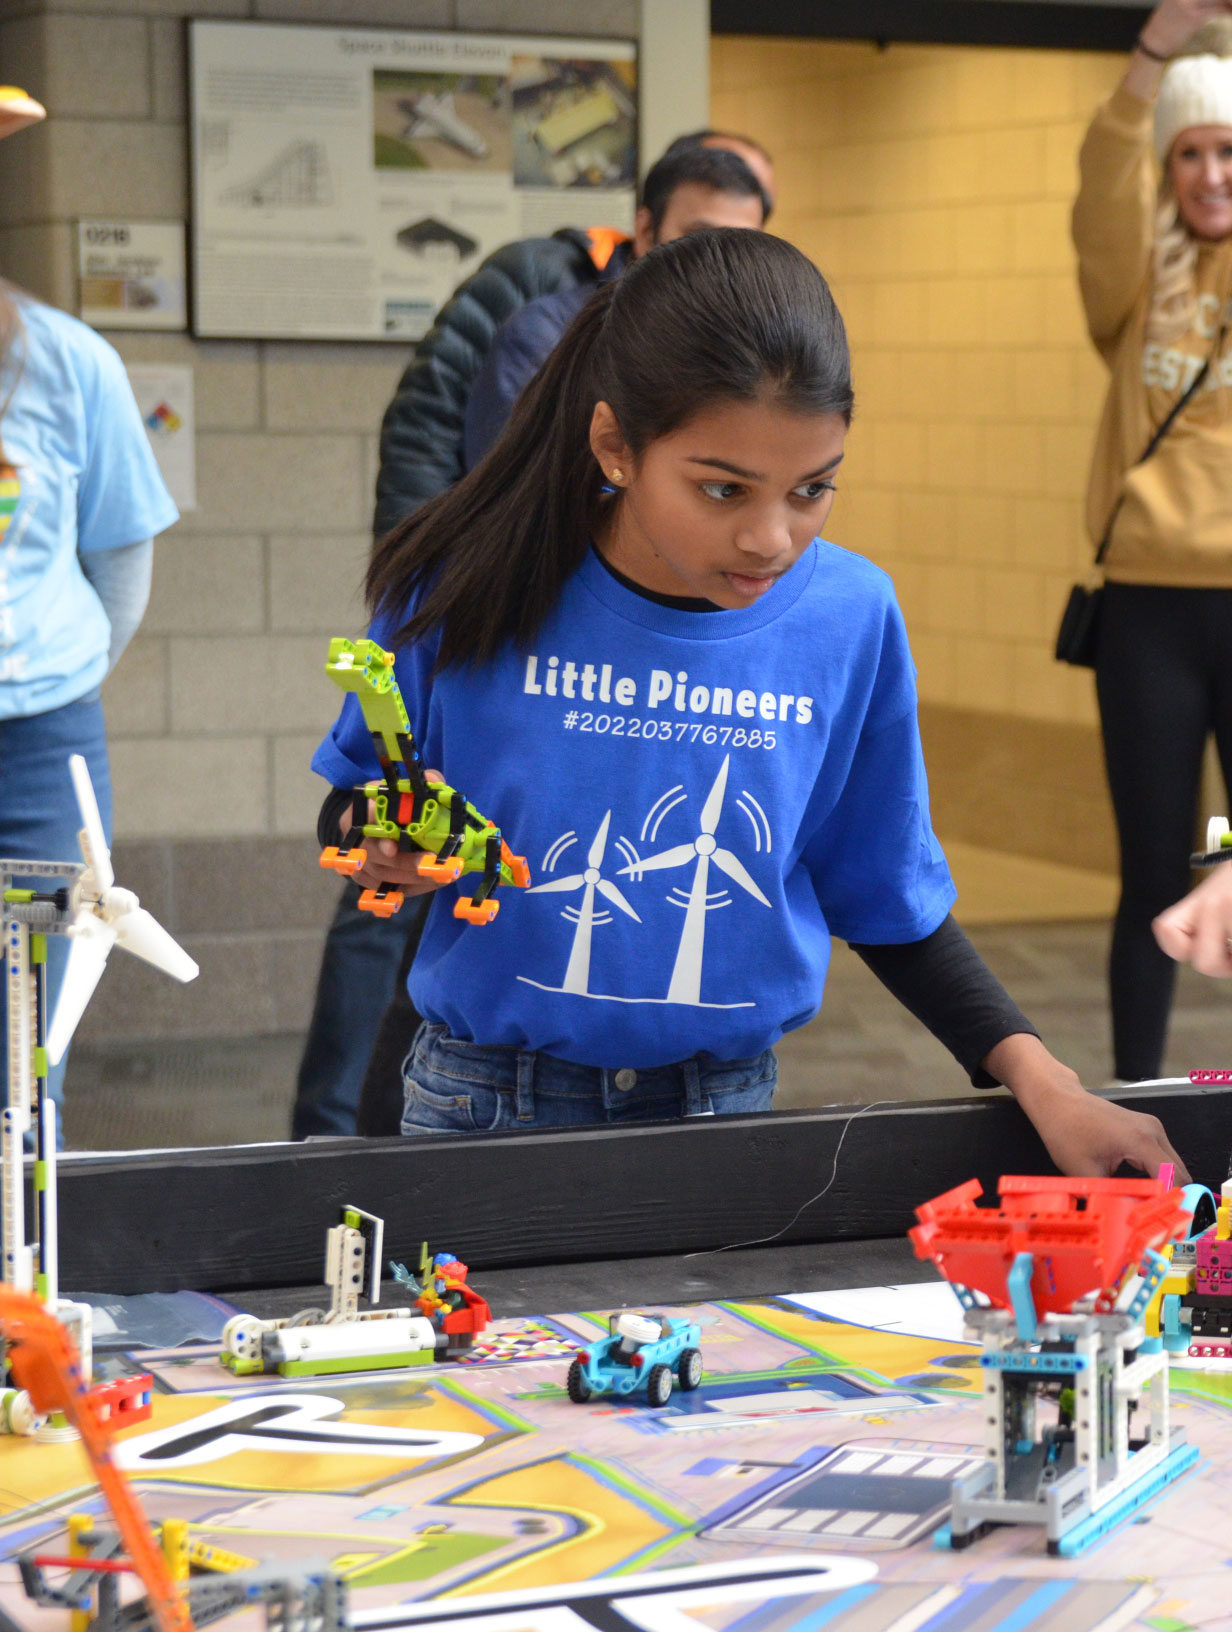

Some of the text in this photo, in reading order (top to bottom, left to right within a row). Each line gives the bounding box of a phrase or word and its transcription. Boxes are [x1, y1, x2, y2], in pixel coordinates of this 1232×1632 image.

[523, 655, 814, 724] Little Pioneers
[563, 710, 777, 750] #2022037767885
